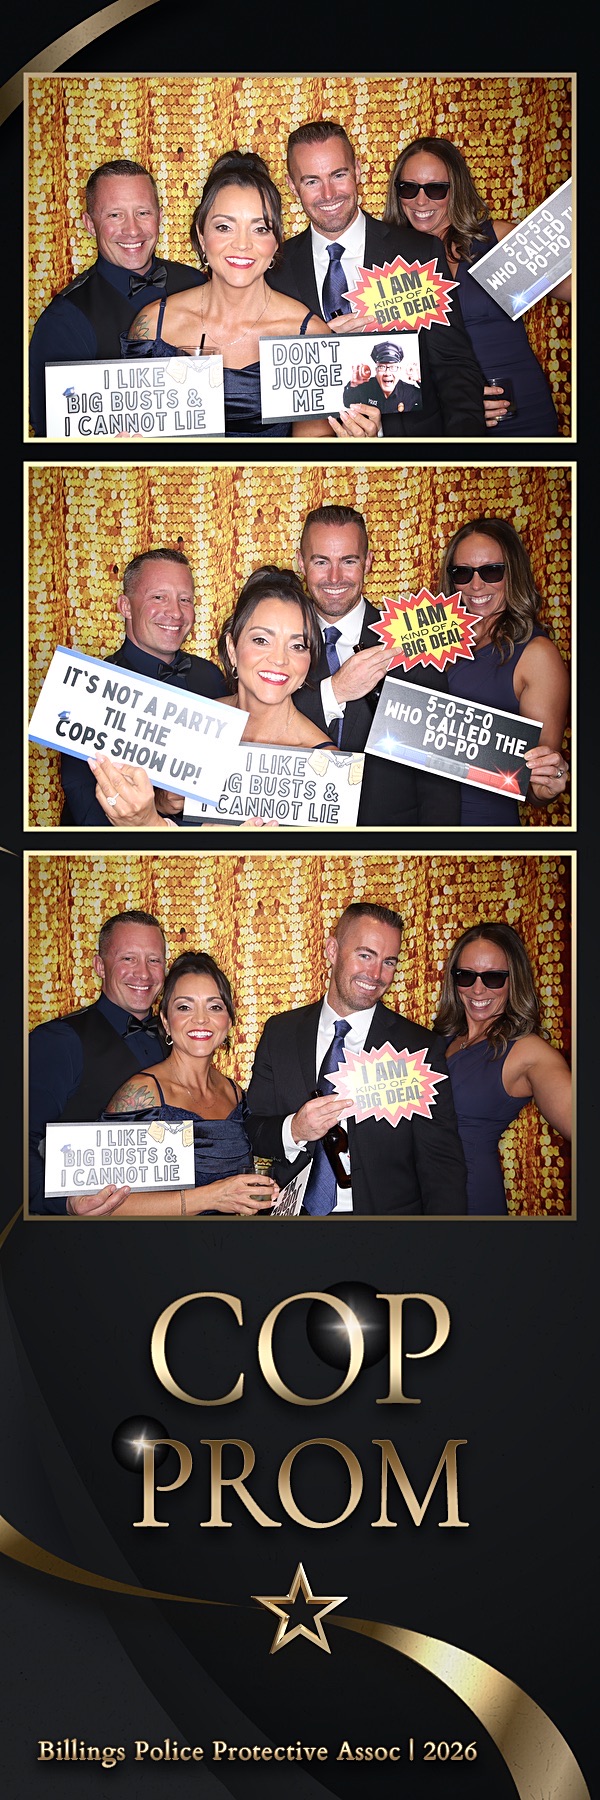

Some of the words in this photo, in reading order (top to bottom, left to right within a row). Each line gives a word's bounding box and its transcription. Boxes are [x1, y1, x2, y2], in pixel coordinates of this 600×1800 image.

[503, 209, 554, 257] 5-0-5-0
[486, 261, 517, 290] WHO
[516, 218, 564, 265] CALLED
[526, 235, 570, 276] PO-PO
[374, 296, 403, 309] KIND
[406, 290, 422, 300] OF
[425, 286, 434, 294] A
[376, 280, 386, 299] I
[390, 270, 422, 296] AM
[374, 308, 402, 326] BIG
[404, 294, 440, 316] DEAL
[272, 341, 340, 366] DON'T
[104, 370, 110, 390] I
[117, 367, 166, 388] LIKE
[272, 364, 343, 390] JUDGE
[67, 392, 104, 414] BIG
[110, 389, 178, 412] BUSTS
[187, 388, 202, 408] &
[292, 389, 324, 412] ME
[64, 417, 70, 436] I
[78, 412, 168, 436] CANNOT
[174, 410, 206, 430] LIE
[402, 612, 412, 632] I
[416, 603, 448, 627] AM
[400, 628, 430, 641] KIND
[432, 623, 447, 632] OF
[402, 640, 428, 658] BIG
[430, 628, 464, 650] DEAL
[62, 666, 100, 694] IT'S
[102, 680, 144, 709] NOT
[144, 696, 158, 716] A
[162, 702, 228, 739] PARTY
[426, 696, 494, 730] 5-0-5-0
[104, 706, 126, 732] TIL
[134, 718, 172, 747] THE
[384, 700, 422, 725] WHO
[426, 713, 491, 746] CALLED
[495, 733, 528, 758] THE
[56, 719, 108, 750] COPS
[110, 738, 166, 772] SHOW
[170, 758, 202, 785] UP!
[422, 730, 479, 760] PO-PO
[246, 752, 252, 772] I
[258, 754, 307, 776] LIKE
[250, 775, 316, 800] BUSTS
[323, 782, 339, 802] &
[215, 794, 302, 820] CANNOT
[308, 803, 340, 824] LIE
[361, 1065, 369, 1084] I
[376, 1058, 408, 1079] AM
[356, 1083, 386, 1093] KIND
[390, 1079, 407, 1088] OF
[356, 1094, 382, 1110] BIG
[386, 1085, 424, 1104] DEAL
[96, 1130, 102, 1147] I
[108, 1129, 148, 1146] LIKE
[64, 1150, 95, 1167] BIG
[102, 1147, 158, 1166] BUSTS
[164, 1147, 178, 1164] &
[60, 1169, 66, 1188] I
[72, 1166, 148, 1186] CANNOT
[154, 1164, 180, 1182] LIE
